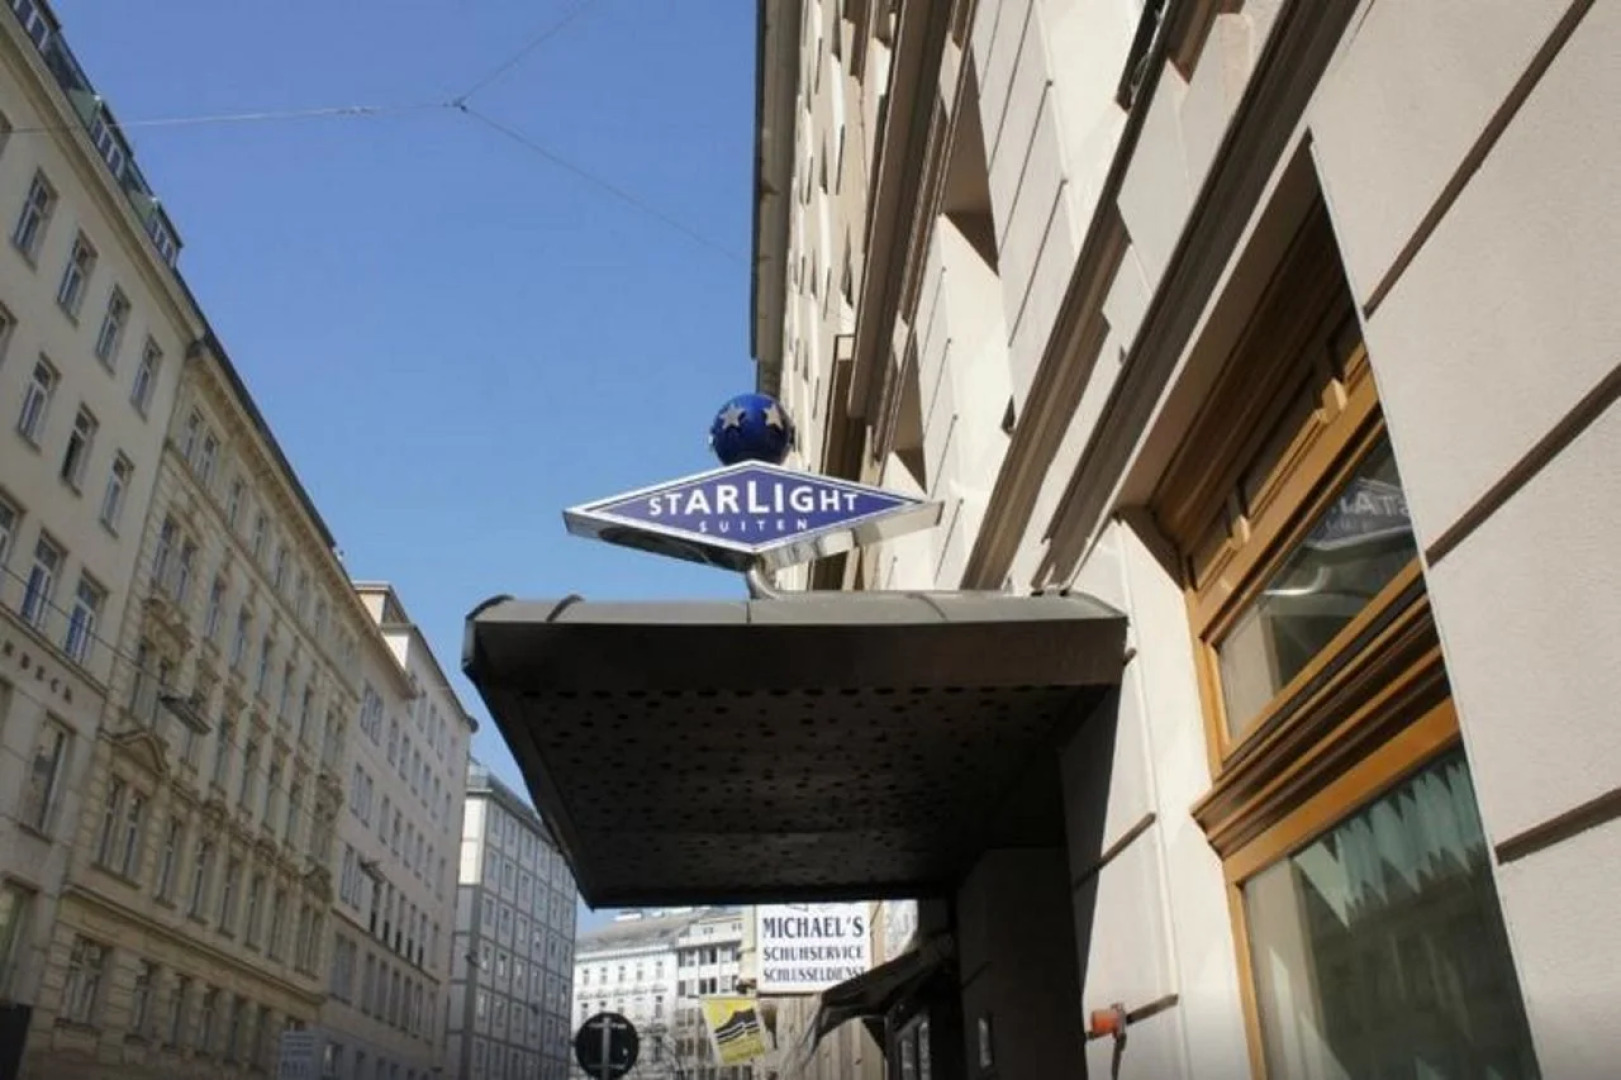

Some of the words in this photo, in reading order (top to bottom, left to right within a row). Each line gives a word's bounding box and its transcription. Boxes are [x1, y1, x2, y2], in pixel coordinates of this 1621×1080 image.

[649, 480, 859, 516] STARLIGHT
[699, 519, 808, 533] SUITEN
[763, 916, 864, 938] MICHAEL'S
[763, 946, 863, 961] SCHUHSERVICE
